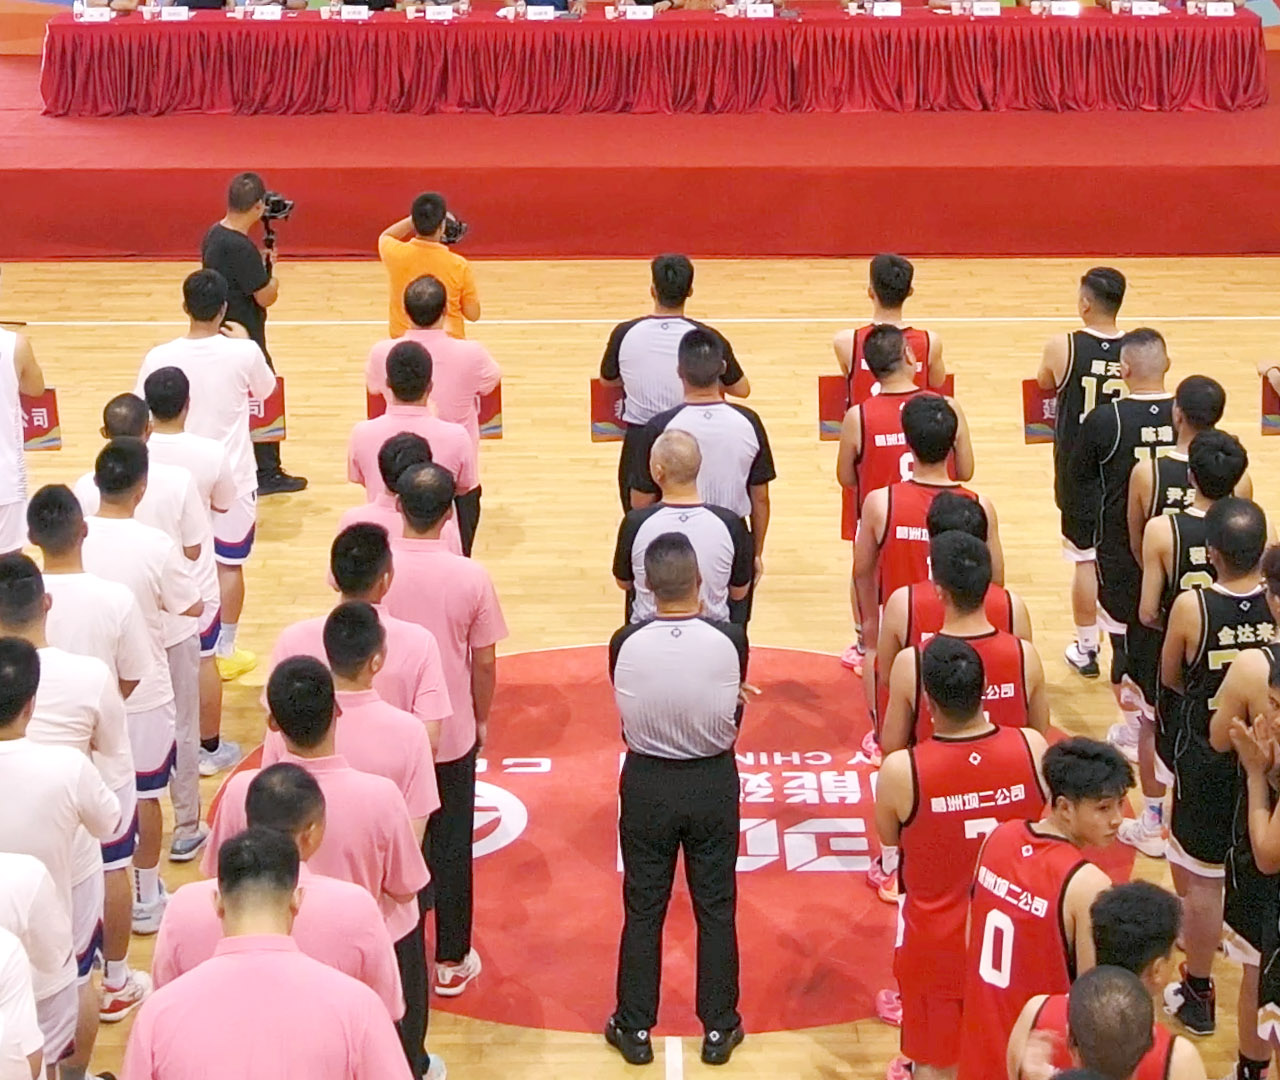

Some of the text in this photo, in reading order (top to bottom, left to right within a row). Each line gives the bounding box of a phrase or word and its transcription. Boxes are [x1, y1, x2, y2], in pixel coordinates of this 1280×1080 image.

[734, 751, 833, 766] CHIN
[930, 784, 1026, 813] 葛洲坝二公司
[978, 907, 1015, 989] 0
